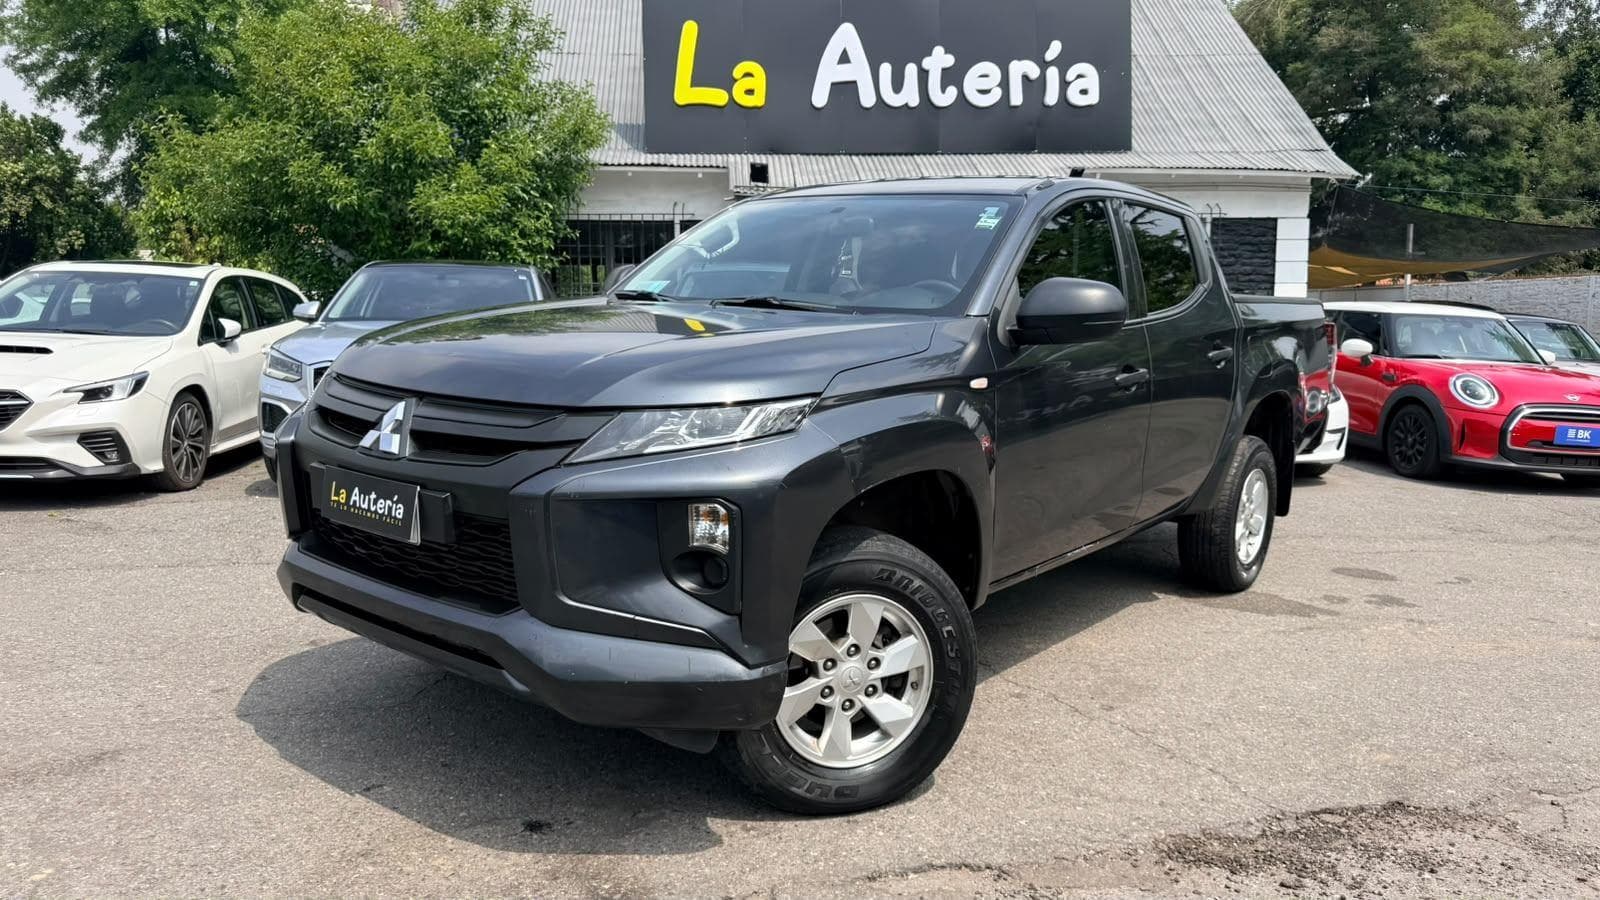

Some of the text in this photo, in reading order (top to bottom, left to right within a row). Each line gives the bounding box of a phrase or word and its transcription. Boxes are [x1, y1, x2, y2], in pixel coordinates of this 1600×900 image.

[673, 20, 1100, 109] La Autería
[1578, 429, 1591, 439] BK
[330, 480, 404, 519] La Autería
